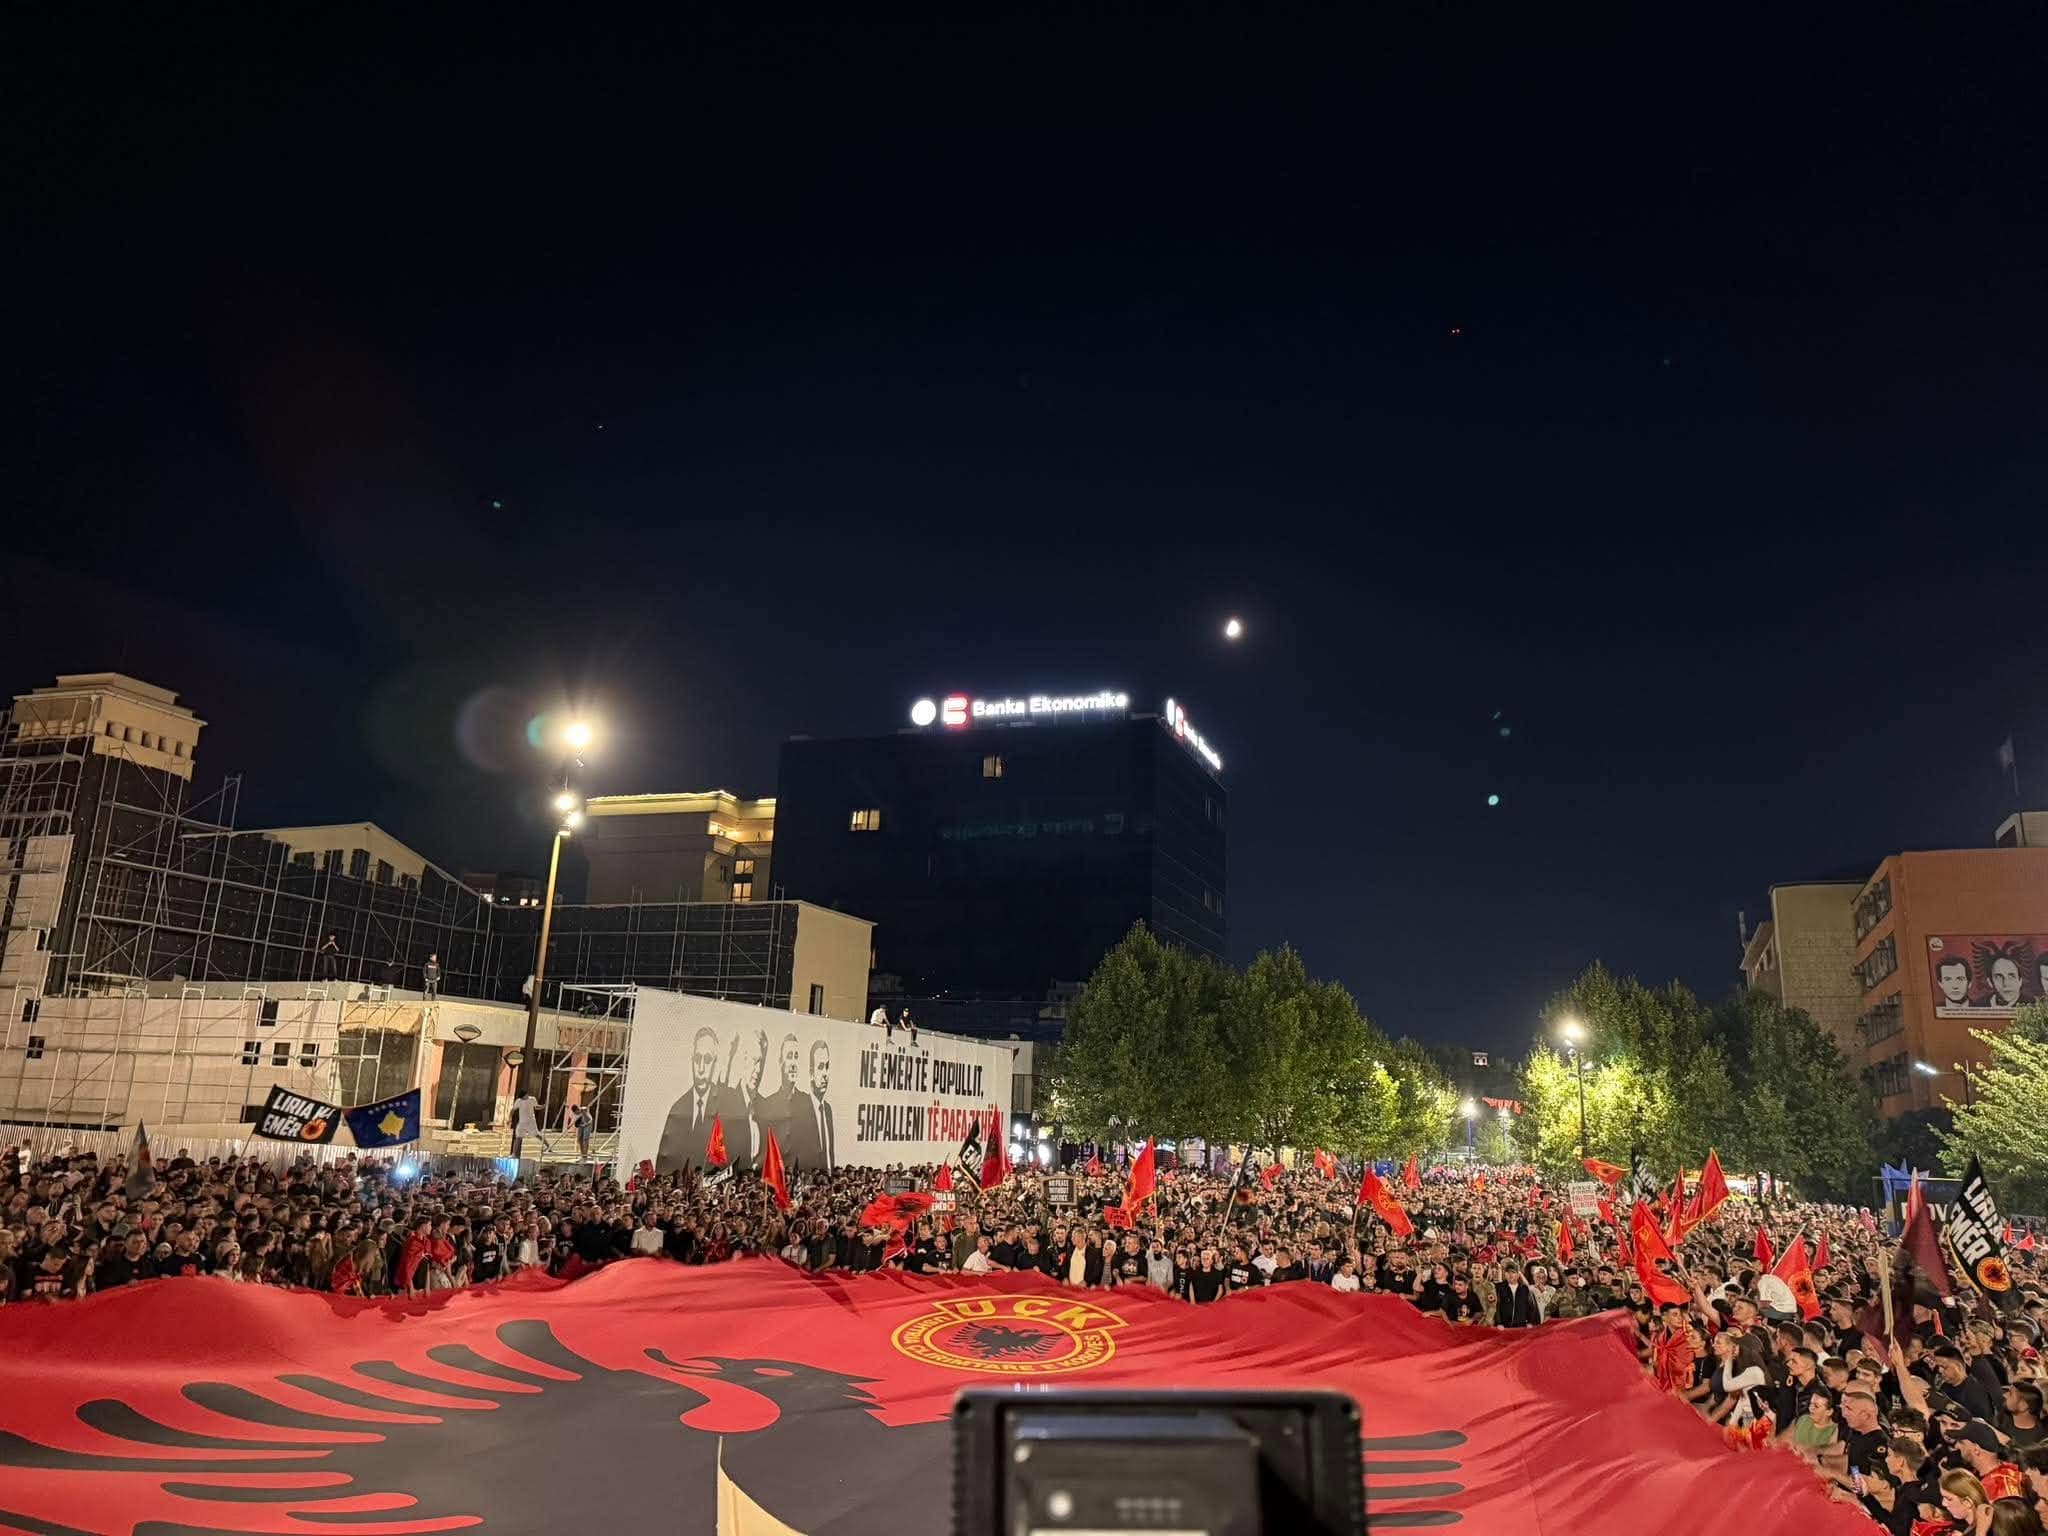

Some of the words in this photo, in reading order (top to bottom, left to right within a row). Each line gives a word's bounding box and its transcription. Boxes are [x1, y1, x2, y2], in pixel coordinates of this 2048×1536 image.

[972, 700, 1025, 717] Banka
[859, 1043, 879, 1089] NË
[880, 1047, 912, 1091] EMËR
[915, 1051, 929, 1092] TË
[932, 1060, 984, 1099] POPULLIT,
[272, 1092, 315, 1119] LIRIA
[262, 1113, 303, 1137] EMËR
[857, 1104, 925, 1142] SHPALLENI
[927, 1100, 940, 1141] TË
[956, 1299, 1107, 1330] UÇK
